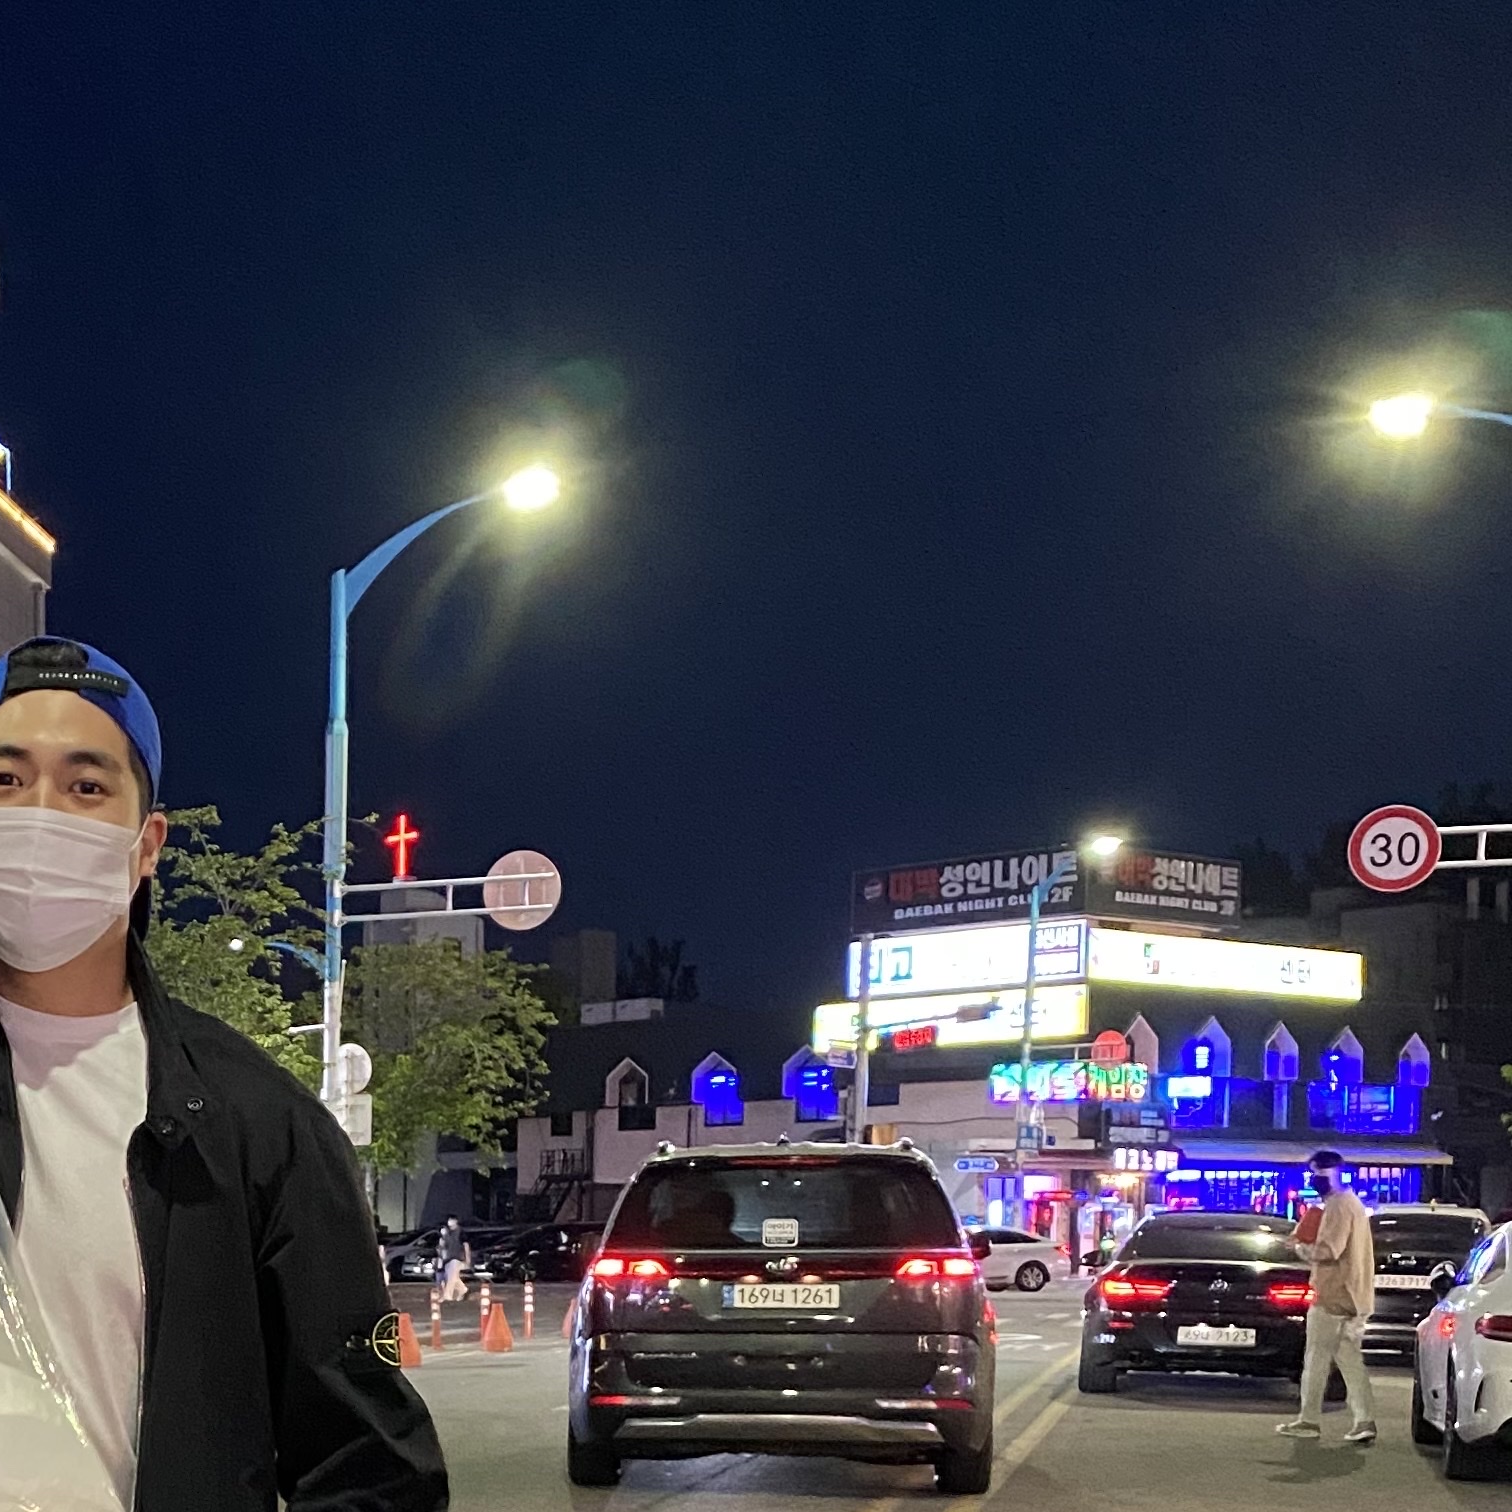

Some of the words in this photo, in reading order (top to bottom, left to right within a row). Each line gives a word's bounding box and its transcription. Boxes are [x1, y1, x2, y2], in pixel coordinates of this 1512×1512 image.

[1369, 831, 1421, 868] 30
[893, 902, 956, 920] DAEBAK
[956, 896, 1005, 913] NIGHT
[1050, 885, 1074, 904] 2F
[1114, 890, 1158, 906] DAEBAK
[1158, 894, 1190, 910] NIGHT
[1191, 898, 1218, 912] CLUB
[737, 1287, 785, 1304] 169너
[791, 1287, 832, 1305] 1261
